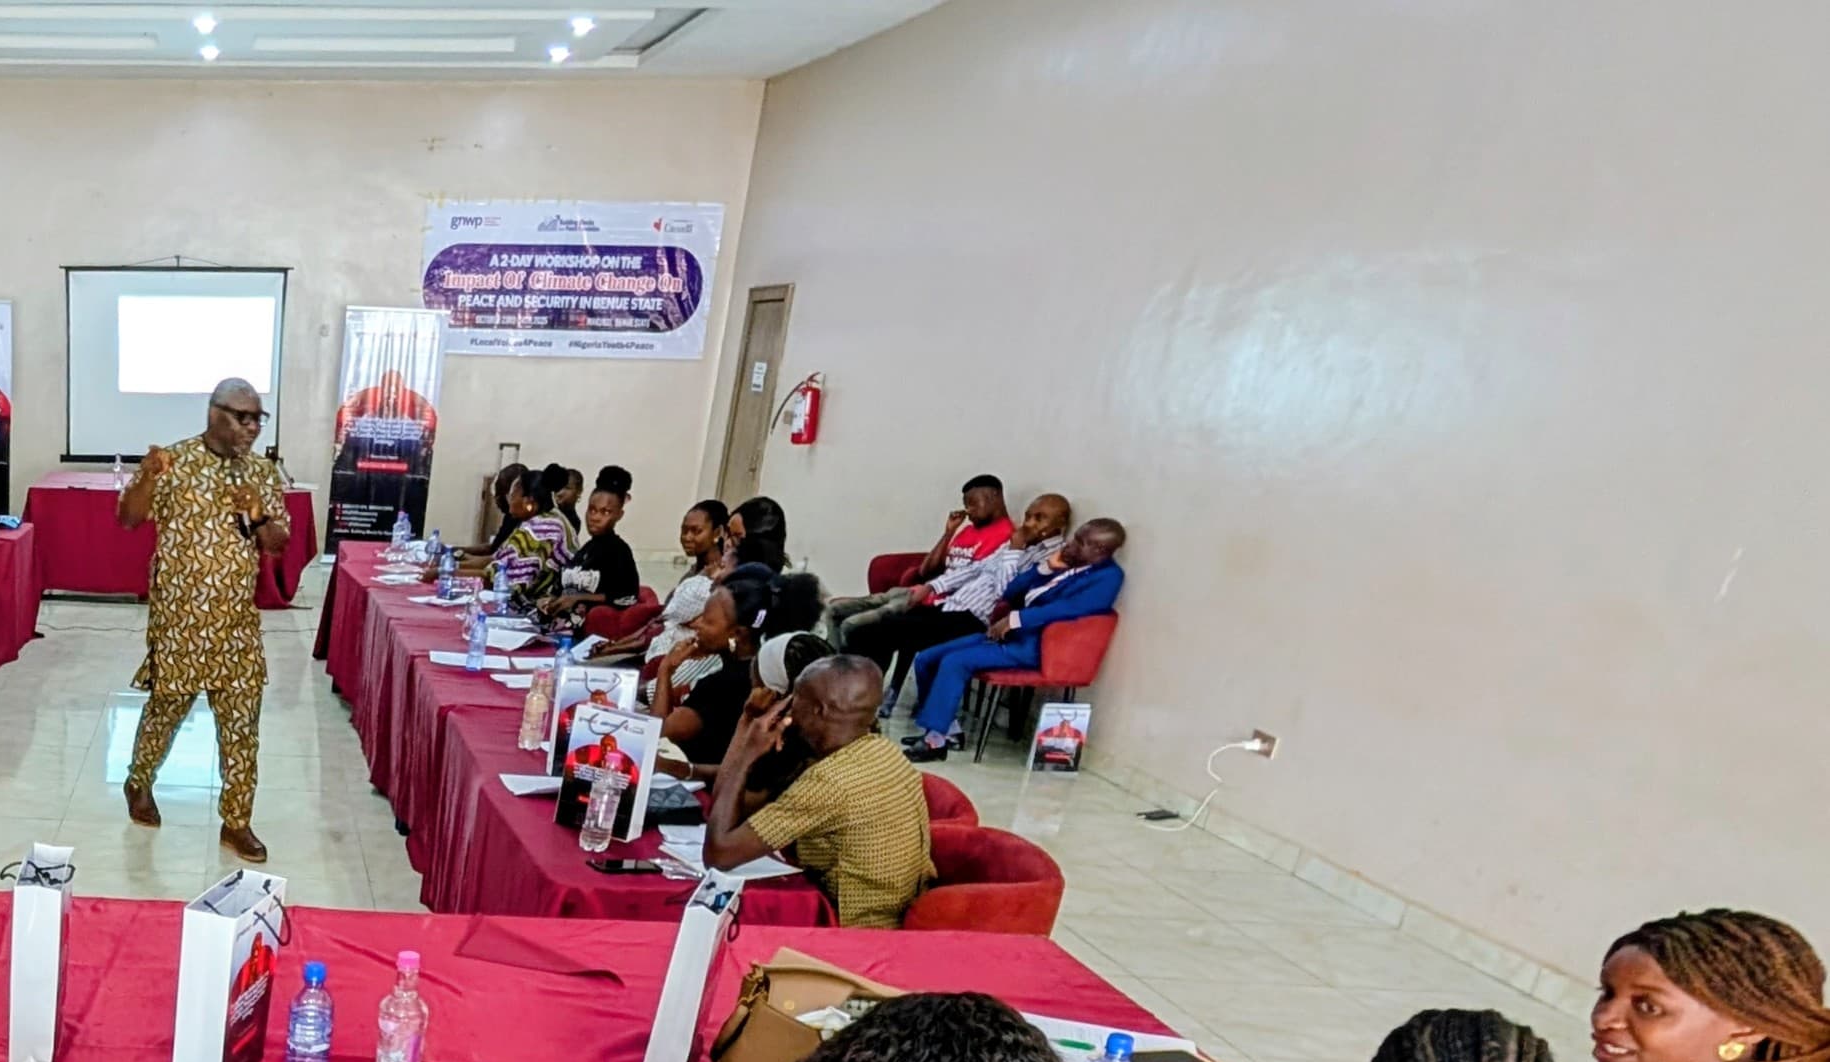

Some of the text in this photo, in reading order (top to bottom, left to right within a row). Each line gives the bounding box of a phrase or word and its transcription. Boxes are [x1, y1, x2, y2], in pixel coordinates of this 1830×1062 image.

[450, 216, 483, 230] gnwp
[489, 253, 643, 270] A 2-DAY WORKSHOP ON THE
[442, 270, 683, 296] Impact Of Climate Change On
[458, 294, 664, 311] PEACE AND SECURITY IN BENUE STATE
[470, 338, 552, 348] #LocalVoies4Peace
